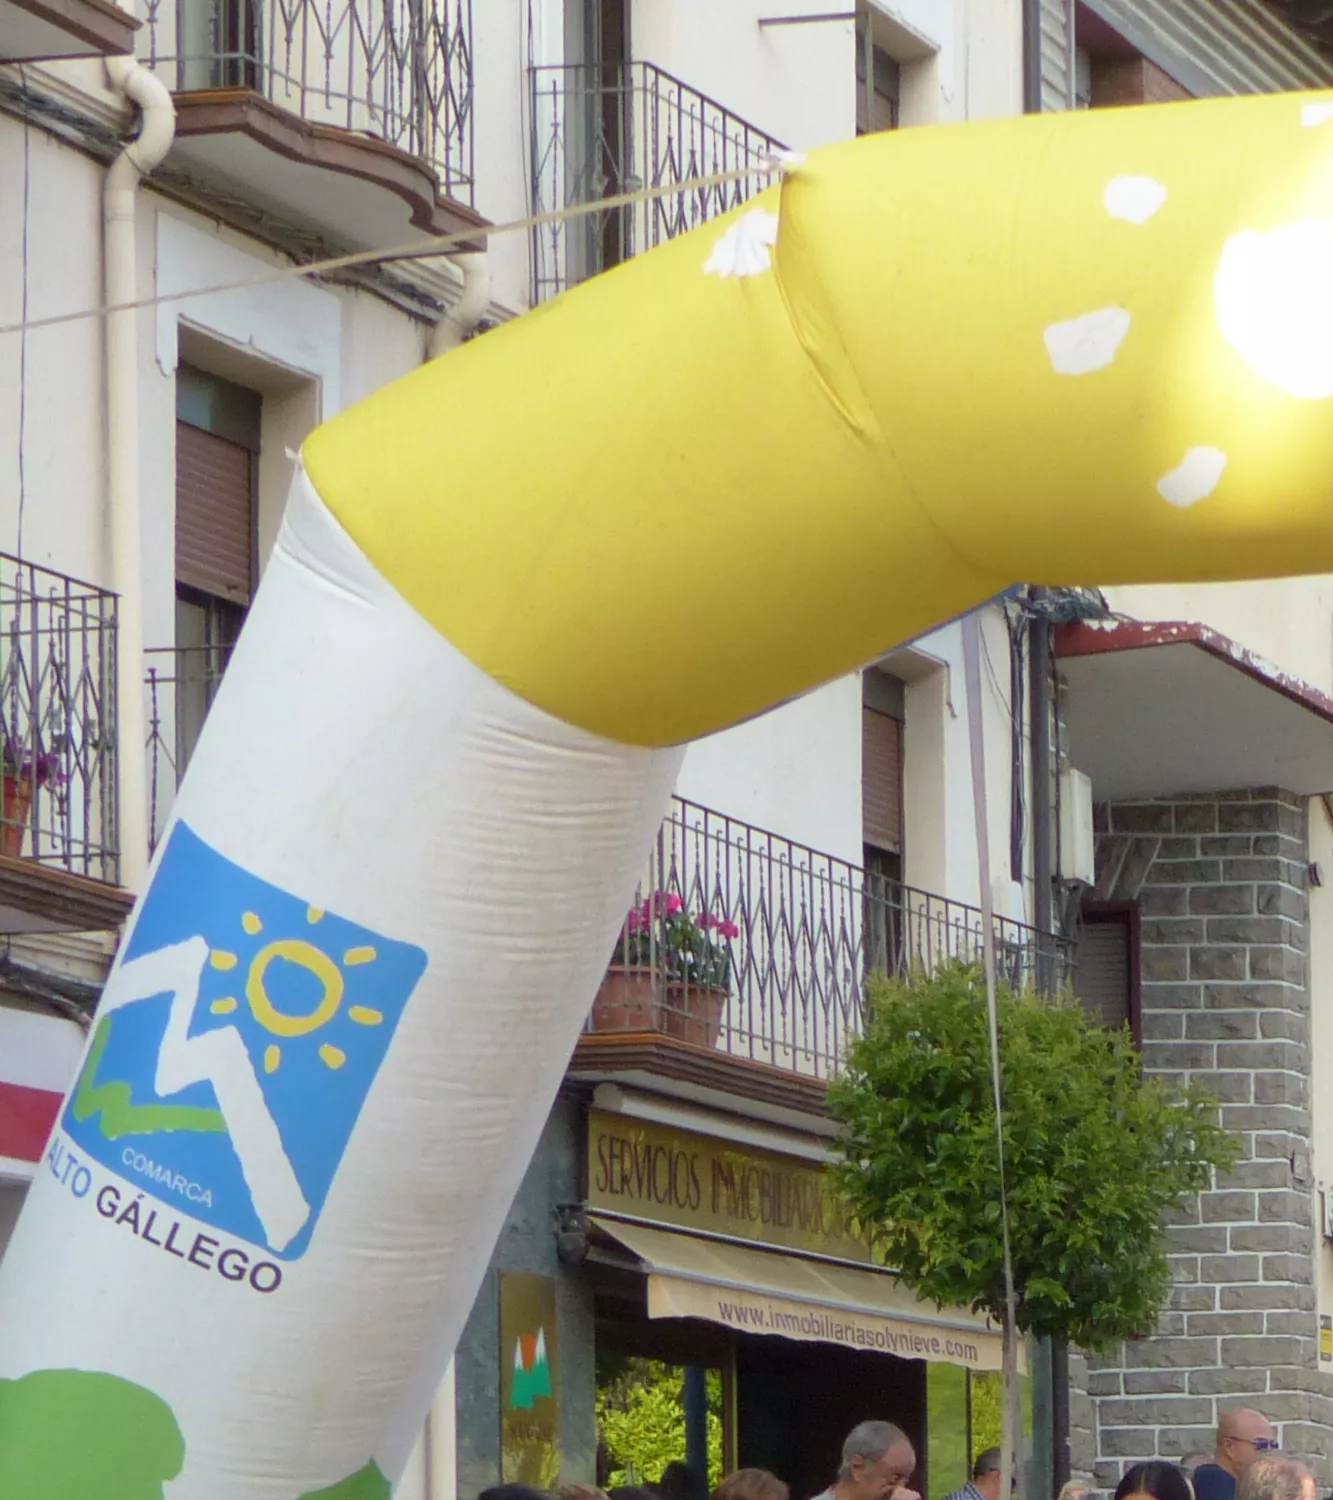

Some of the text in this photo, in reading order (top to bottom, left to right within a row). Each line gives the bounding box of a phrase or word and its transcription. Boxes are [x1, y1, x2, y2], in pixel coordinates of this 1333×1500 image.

[122, 1148, 213, 1208] COMARCA
[597, 1133, 700, 1211] SERVICIOS
[48, 1137, 282, 1294] ALTO GÁLLEGO
